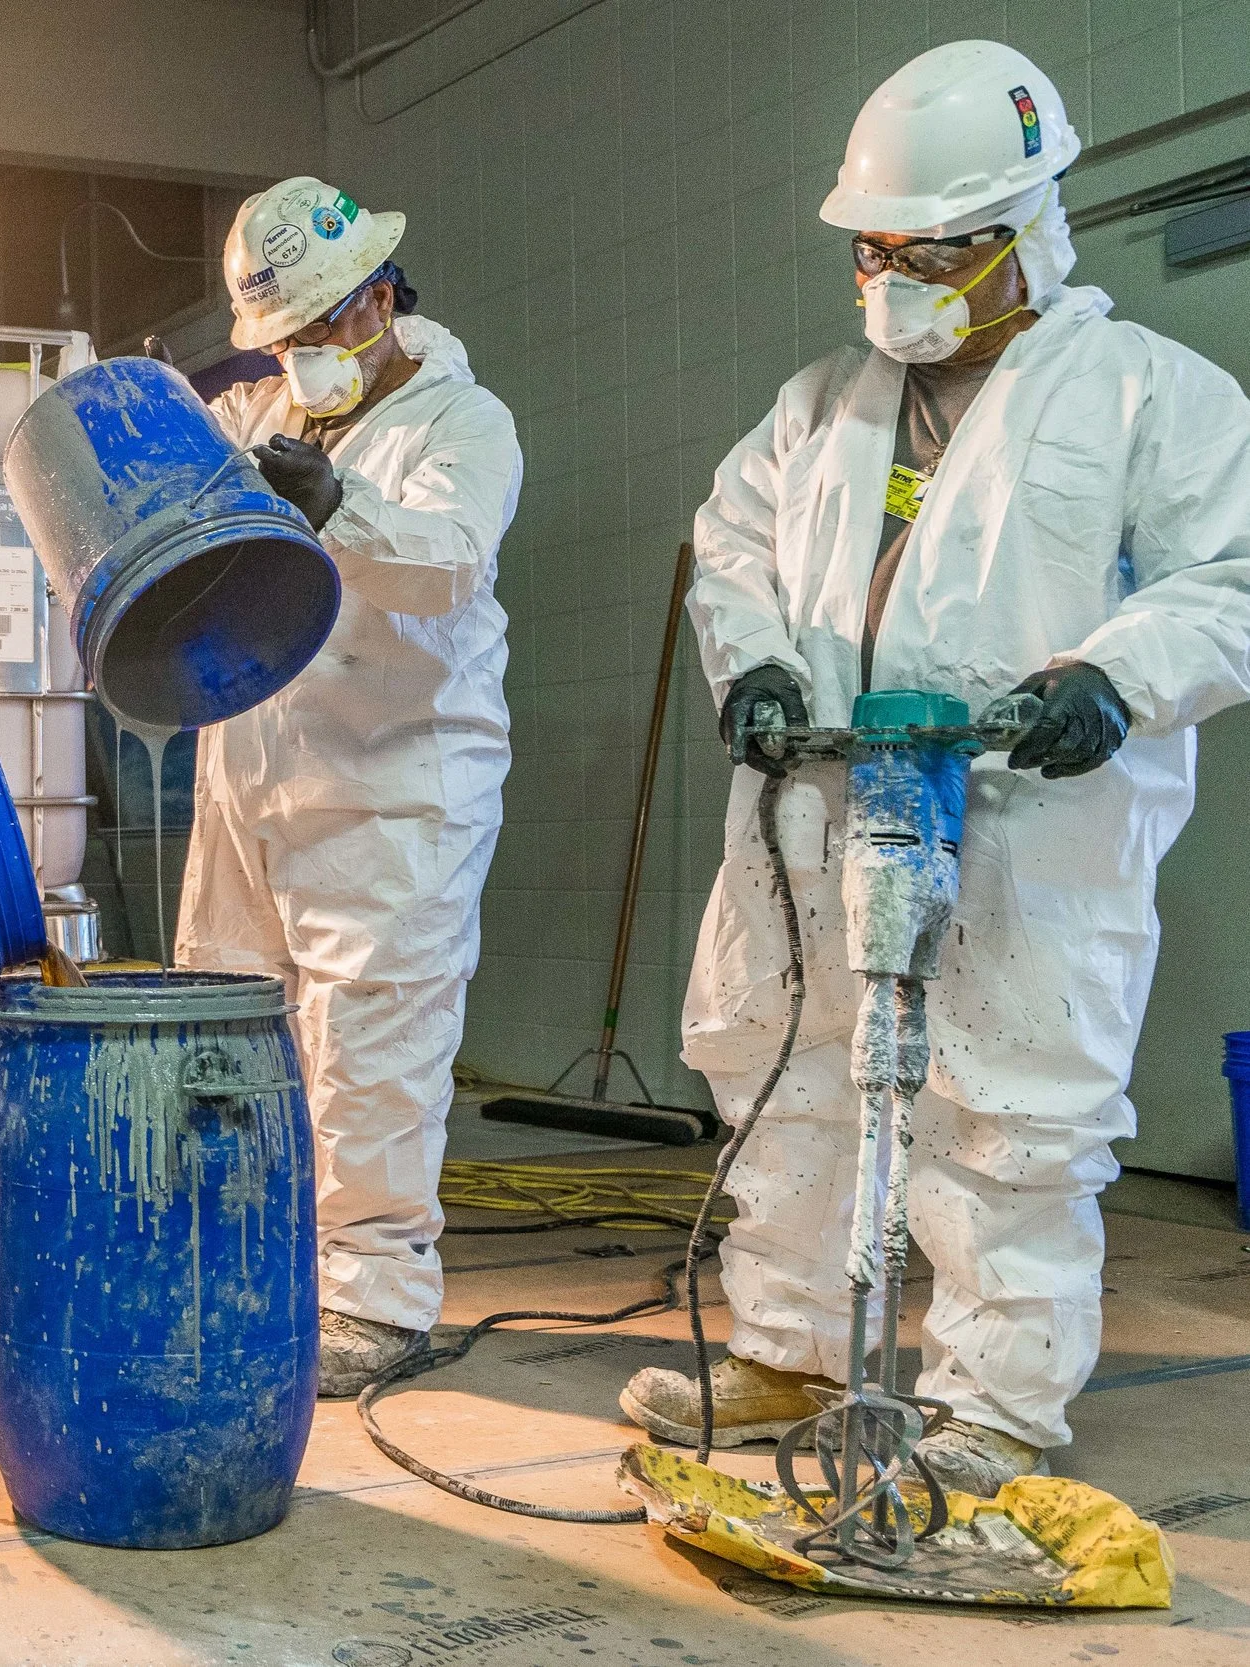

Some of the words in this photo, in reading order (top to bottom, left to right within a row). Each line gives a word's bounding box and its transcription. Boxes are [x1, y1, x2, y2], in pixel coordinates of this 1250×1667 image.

[266, 227, 288, 244] Turner
[267, 231, 298, 256] Alamodome
[281, 245, 297, 259] 674
[236, 266, 276, 291] Vulcan
[257, 283, 281, 301] SAFETY
[409, 1606, 600, 1656] FLOORSHELL
